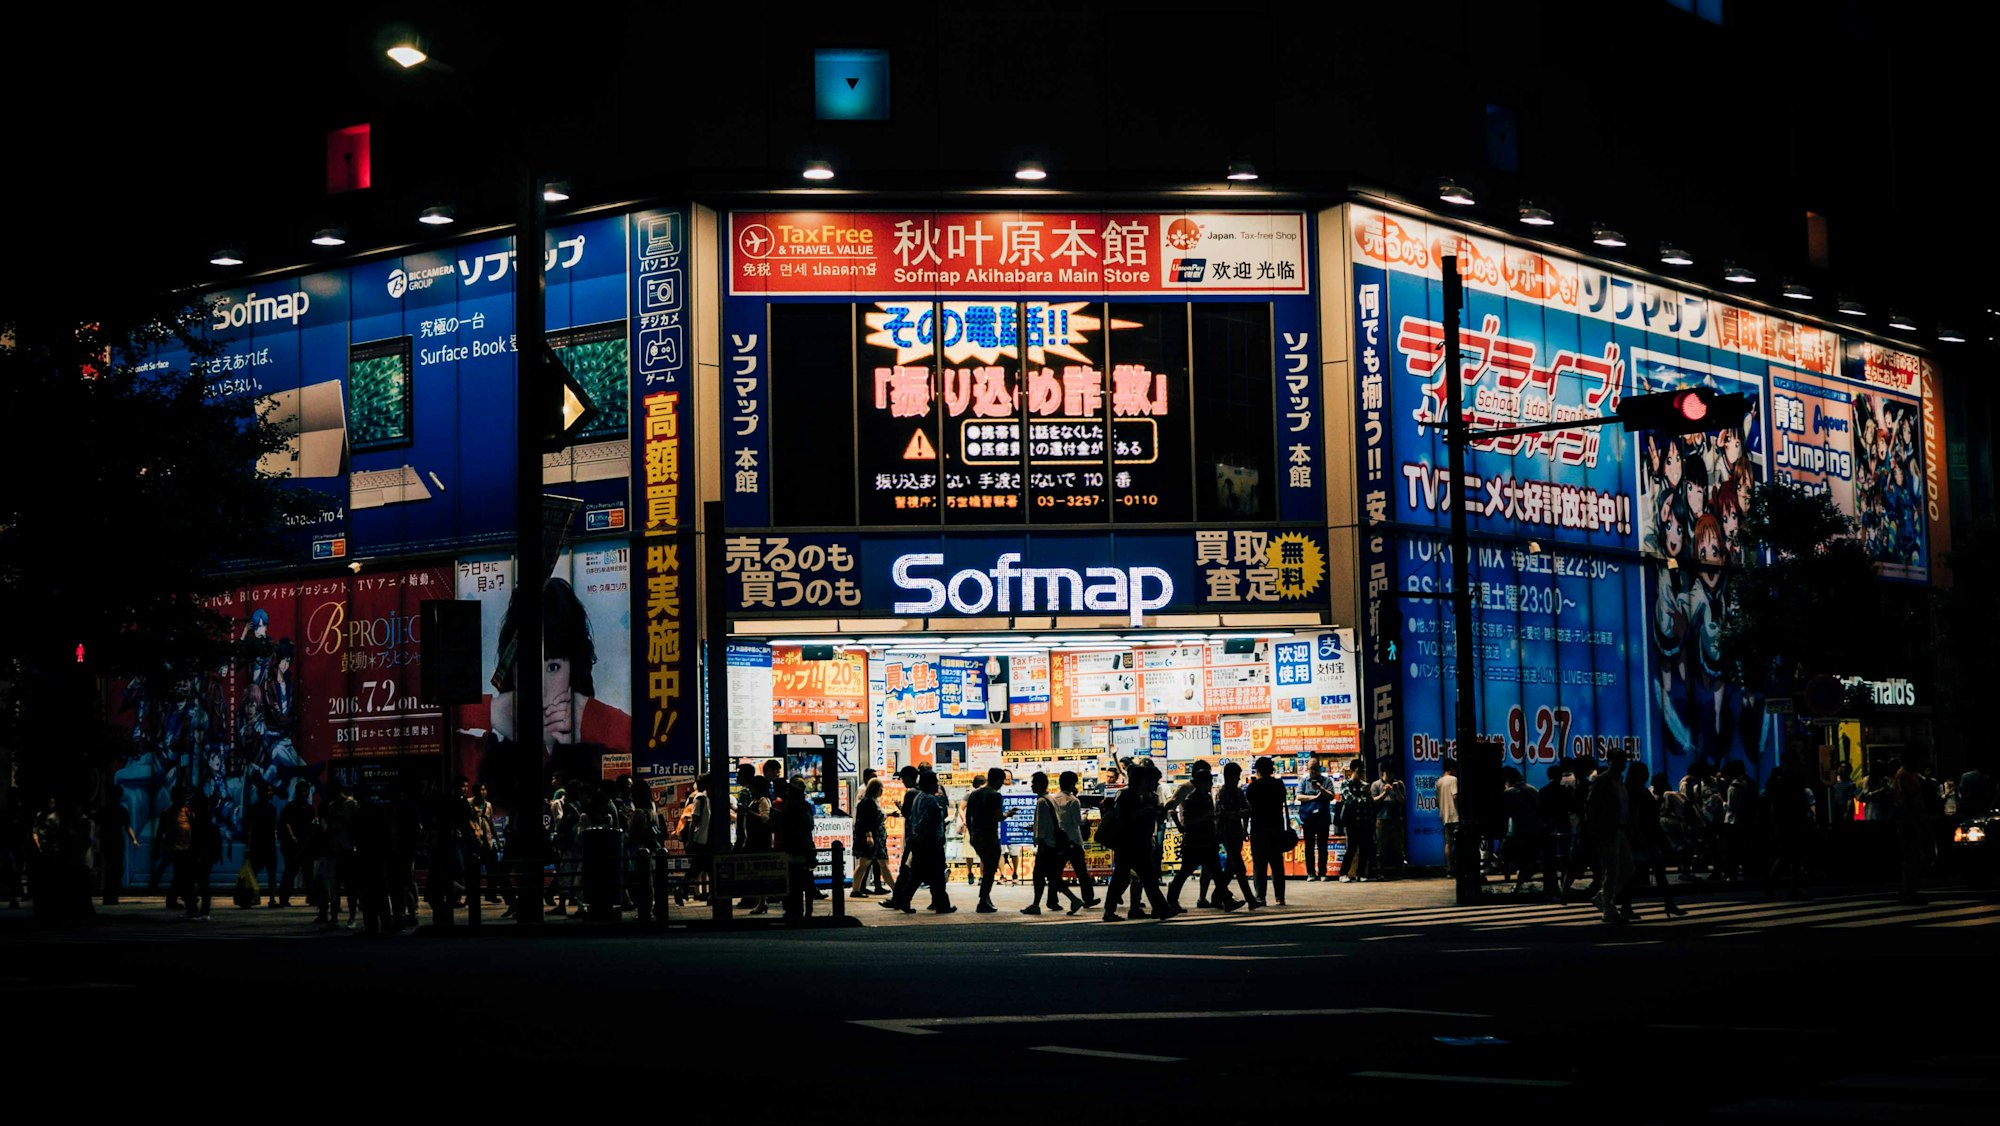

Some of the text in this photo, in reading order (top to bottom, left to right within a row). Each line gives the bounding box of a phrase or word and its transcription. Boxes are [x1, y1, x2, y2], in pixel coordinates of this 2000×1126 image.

[893, 219, 1150, 266] 秋叶原本館
[1207, 231, 1297, 241] Japan. Tax-free Shop
[1364, 222, 1428, 266] 売るのも
[778, 245, 874, 255] & TRAVEL VALUE
[409, 264, 455, 281] BIC CAMERA
[640, 256, 680, 273] パソコン
[743, 262, 771, 276] 免税
[780, 262, 808, 277] 면세
[893, 268, 1150, 286] Sofmap Akihabara Main Store
[1171, 263, 1205, 273] UnionPay
[409, 278, 433, 291] GROUP
[1505, 258, 1578, 305] サポートも!
[212, 291, 310, 331] Sofmap
[1583, 274, 1708, 338] ソフマップ
[420, 311, 485, 338] 究極の一台
[640, 313, 680, 329] デジカメ
[883, 305, 1069, 348] その電話!!
[420, 343, 469, 366] Surface
[473, 336, 506, 358] Book
[646, 374, 675, 386] ゲーム
[731, 333, 759, 493] ソフマップ 本館
[1283, 332, 1312, 488] ソフマップ 本館
[1477, 389, 1519, 414] School
[1525, 397, 1551, 417] idol
[1773, 395, 1805, 433] 青空
[1921, 360, 1940, 523] KANBUNDO
[1776, 433, 1851, 480] Jumping
[336, 507, 344, 521] 4
[725, 536, 854, 573] 売るのも
[1195, 530, 1270, 566] 買取
[460, 561, 498, 578] 今日なに
[1280, 540, 1305, 591] 無料
[478, 574, 505, 592] 見る?
[741, 571, 862, 608] 買うのも
[892, 552, 1174, 627] Sofmap
[1206, 566, 1279, 602] 査定
[1011, 656, 1047, 665] Tax Free
[1278, 645, 1309, 663] 欢迎
[886, 662, 939, 692] 買い替え
[1279, 665, 1310, 683] 使用
[1317, 662, 1345, 676] 支付宝
[398, 696, 418, 710] on
[876, 700, 885, 766] Tax Free
[1114, 735, 1136, 744] Bank
[1252, 730, 1269, 740] 5F
[1508, 704, 1572, 764] 9.27
[1573, 734, 1594, 759] ON
[1412, 733, 1457, 761] Blu-ra
[652, 762, 695, 775] Tax Free
